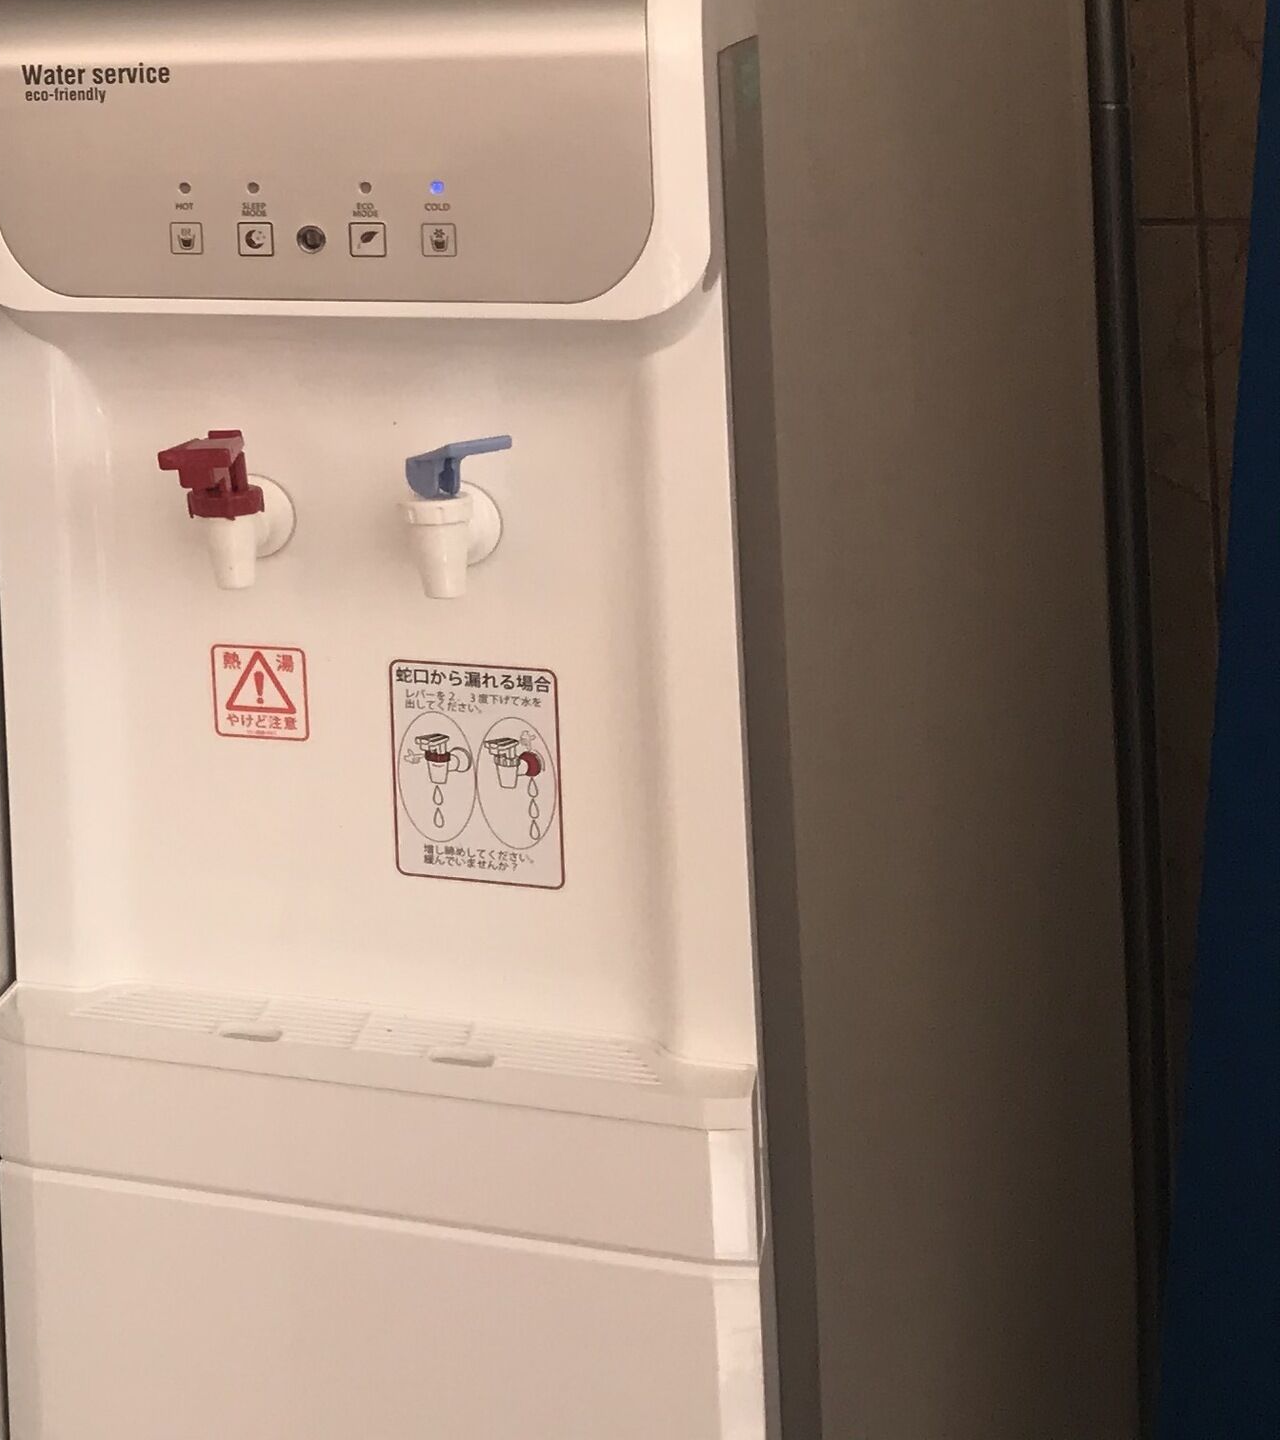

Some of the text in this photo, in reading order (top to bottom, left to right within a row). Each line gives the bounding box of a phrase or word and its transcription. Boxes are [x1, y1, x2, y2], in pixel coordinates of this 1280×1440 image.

[21, 61, 172, 87] Water service
[24, 86, 107, 104] eco-friendly
[175, 202, 194, 211] HOT
[242, 202, 267, 211] SLEEP
[356, 202, 375, 211] ECO
[424, 202, 451, 212] COLD
[241, 210, 267, 218] MODE
[352, 210, 379, 218] MODE
[275, 654, 294, 672] 湯
[395, 666, 552, 693] 蛇口から漏れる場合
[226, 713, 298, 731] やけど注意
